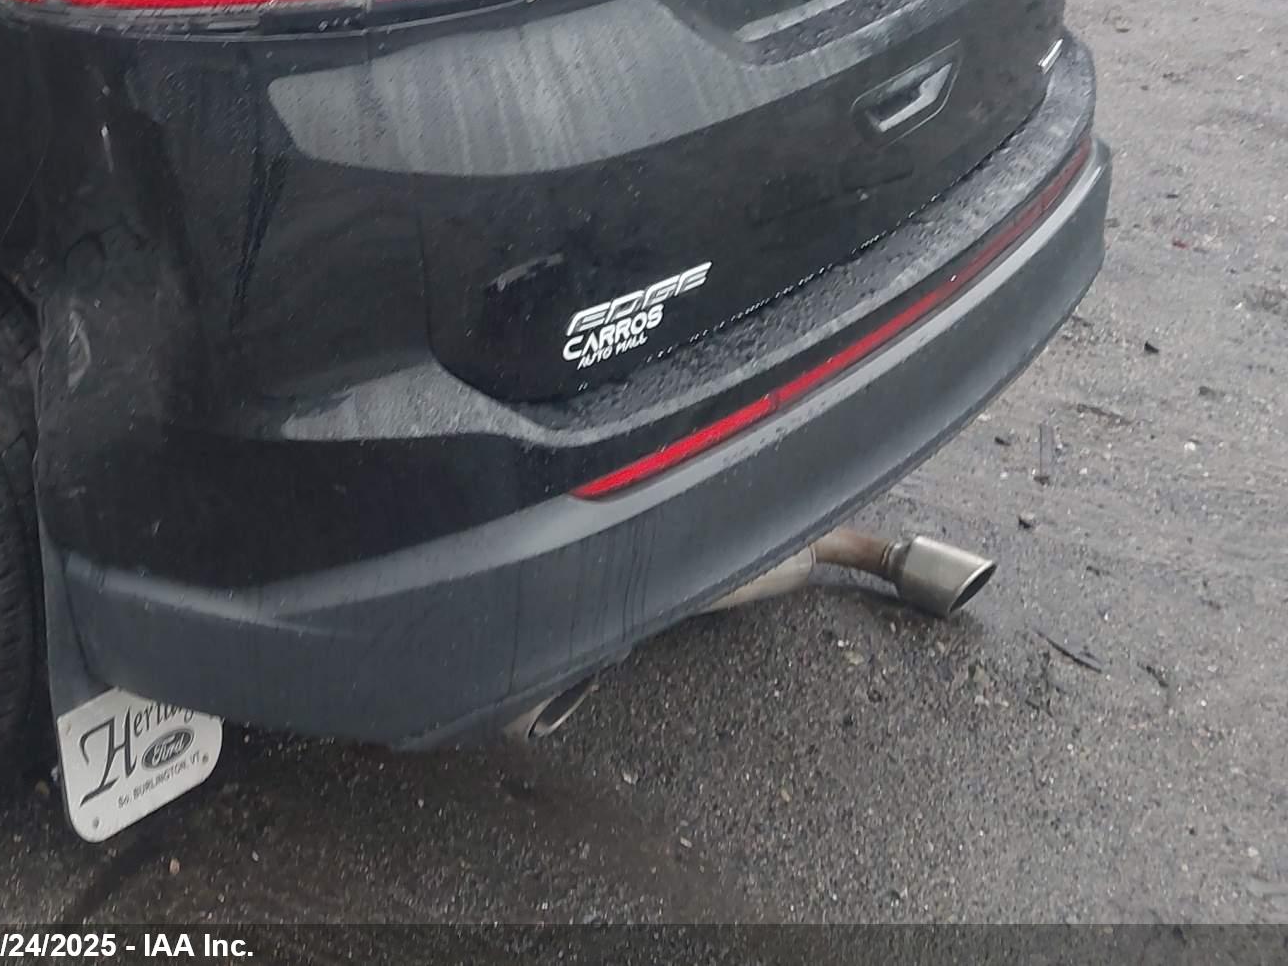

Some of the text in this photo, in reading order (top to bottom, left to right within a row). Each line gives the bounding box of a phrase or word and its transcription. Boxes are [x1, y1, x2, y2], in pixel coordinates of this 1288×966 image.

[562, 303, 665, 361] CARROS
[576, 346, 612, 370] AUTO
[148, 730, 190, 767] Ford
